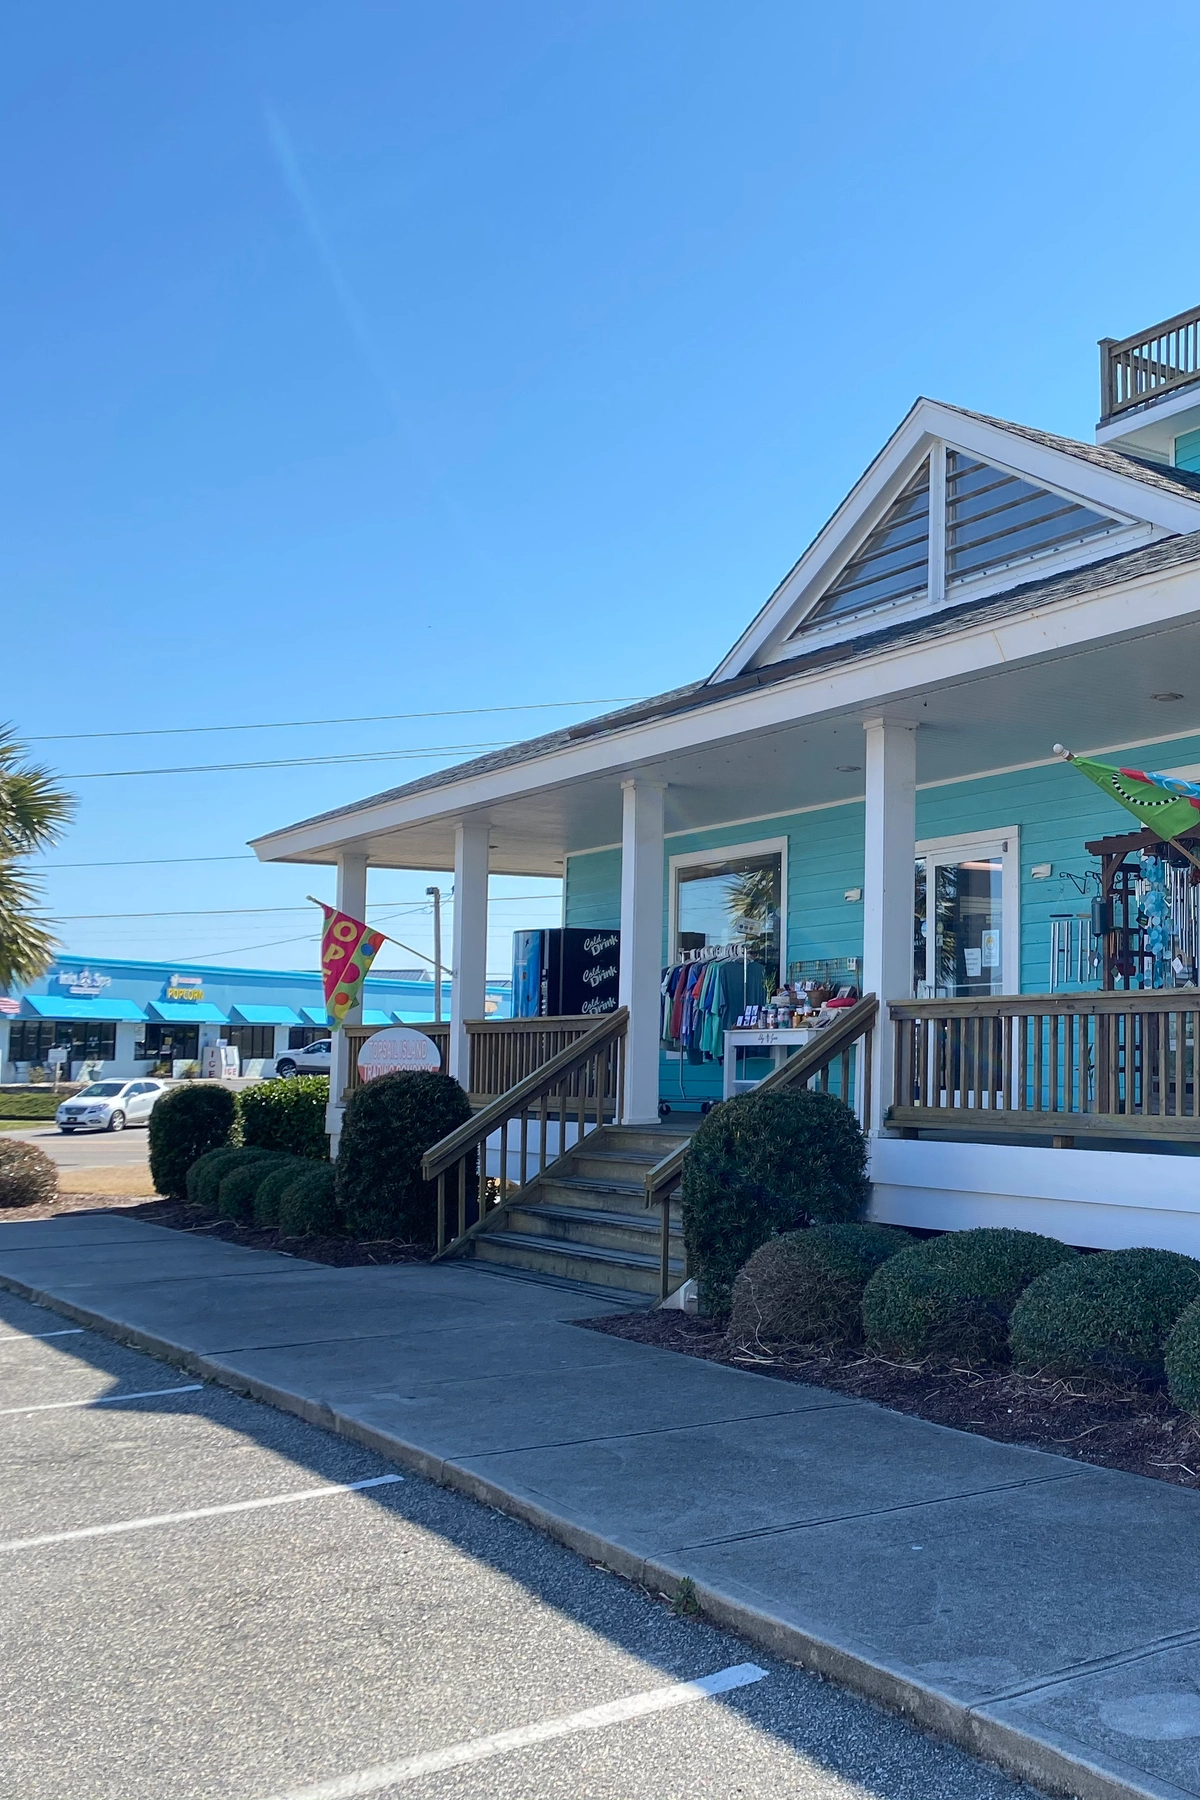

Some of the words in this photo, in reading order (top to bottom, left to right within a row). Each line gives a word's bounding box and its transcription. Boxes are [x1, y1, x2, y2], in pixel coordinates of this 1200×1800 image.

[583, 933, 602, 951] Cold
[591, 934, 619, 956] Drink
[582, 965, 601, 983] Cold
[590, 965, 618, 988] Drink
[167, 988, 204, 1000] POPCORN
[581, 996, 600, 1014] Cold
[589, 996, 617, 1015] Drink
[368, 1040, 398, 1060] TOPSAIL
[400, 1039, 428, 1060] ISLAND
[208, 1050, 216, 1078] ICE
[224, 1068, 237, 1076] ICE
